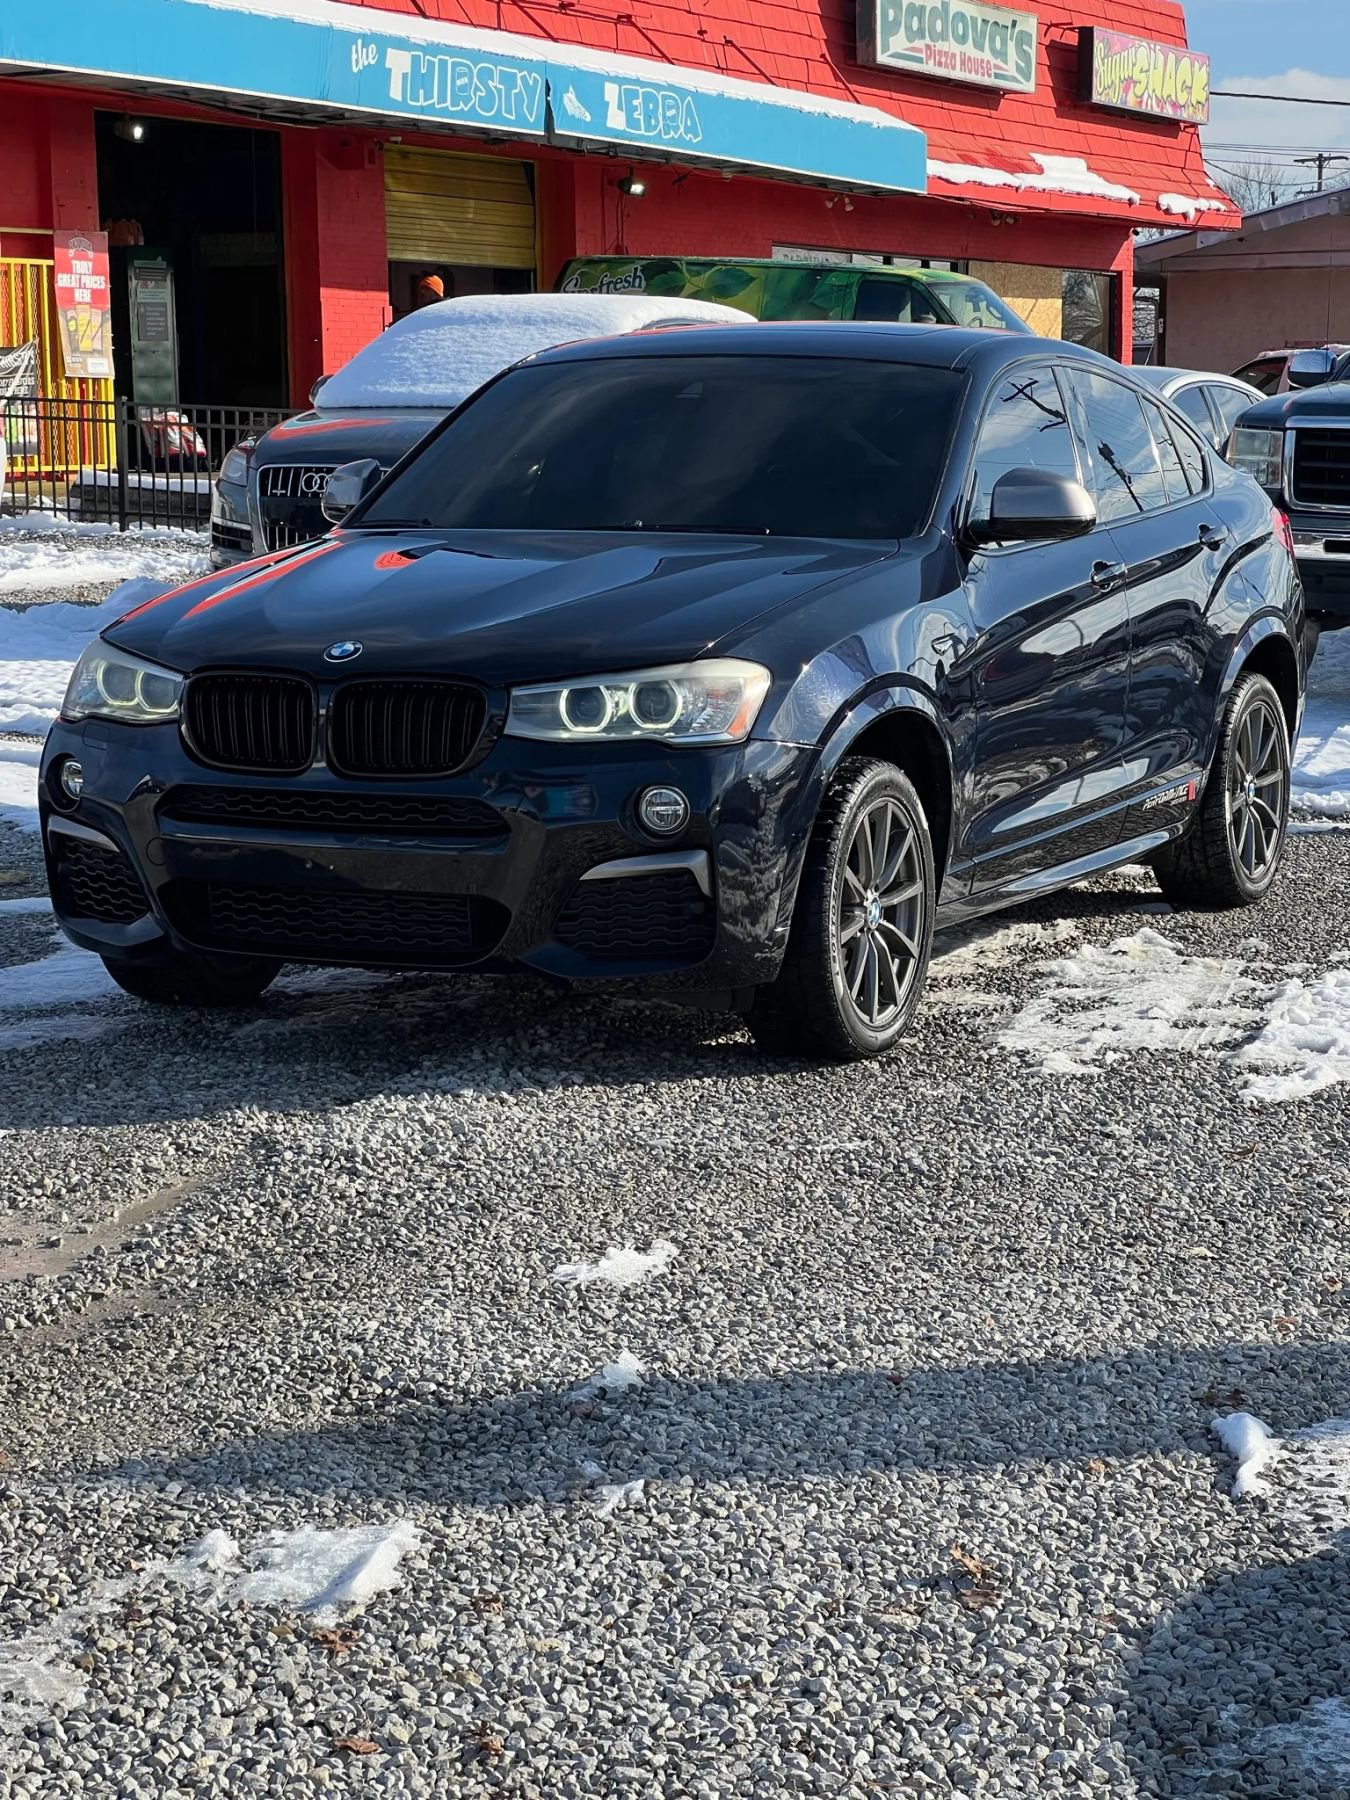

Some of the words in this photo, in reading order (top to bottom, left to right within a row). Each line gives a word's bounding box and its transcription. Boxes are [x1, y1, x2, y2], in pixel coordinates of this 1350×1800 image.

[880, 0, 1033, 83] Padova's
[924, 44, 957, 71] Pizza
[959, 51, 993, 78] House
[1096, 41, 1136, 104] Sugar
[1132, 44, 1209, 108] SHACK
[351, 39, 379, 73] the
[385, 48, 542, 122] THIRSTY
[604, 82, 703, 143] ZEBRA
[57, 273, 80, 288] GREAT
[80, 274, 106, 290] PRICES
[71, 259, 93, 275] TRULY
[74, 288, 92, 303] HERE
